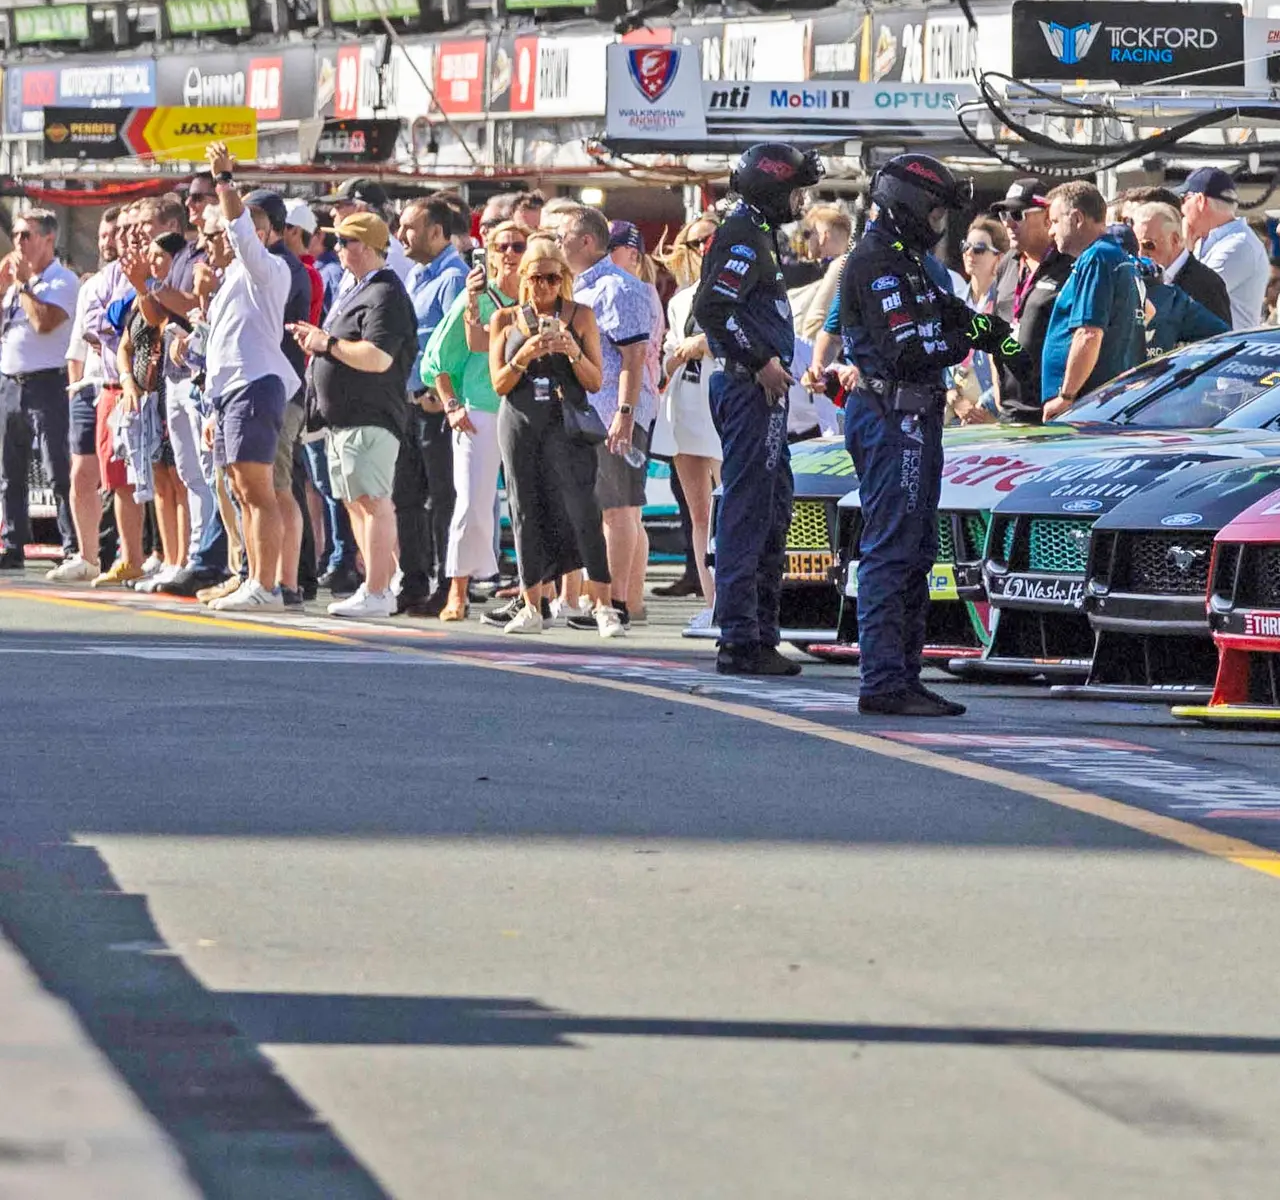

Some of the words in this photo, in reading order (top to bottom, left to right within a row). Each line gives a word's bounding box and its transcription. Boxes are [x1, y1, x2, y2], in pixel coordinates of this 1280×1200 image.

[1105, 27, 1219, 50] TICKFORD
[1111, 49, 1173, 64] RACING
[709, 85, 750, 109] nti
[770, 88, 827, 109] Mobil
[875, 91, 956, 110] OPTUS
[174, 122, 218, 136] JAX
